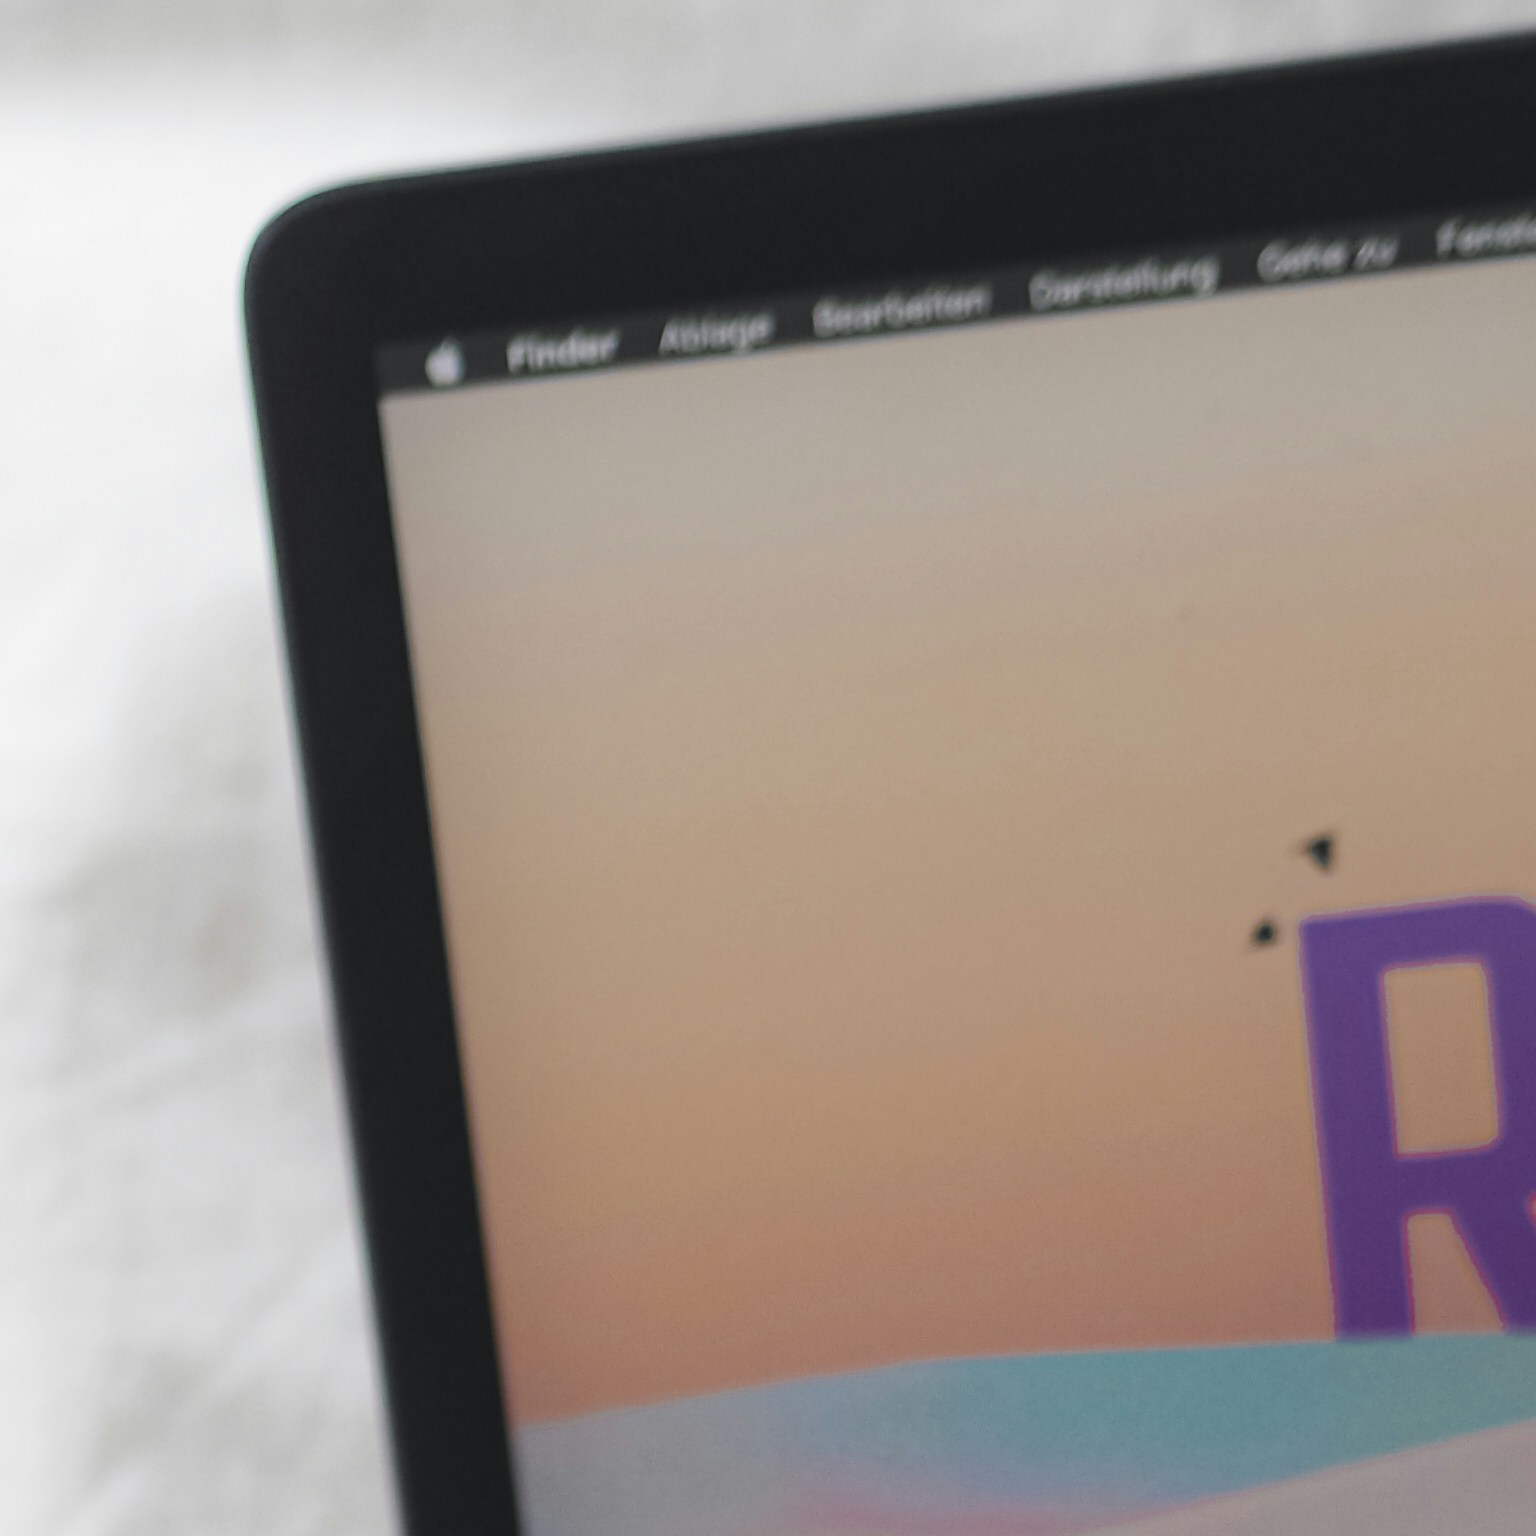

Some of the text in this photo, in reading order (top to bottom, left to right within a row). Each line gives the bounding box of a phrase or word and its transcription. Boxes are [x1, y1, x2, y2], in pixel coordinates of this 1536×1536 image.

[506, 329, 621, 375] Finder
[659, 311, 776, 357] Ablage
[812, 284, 993, 339] Bearbeiten
[1029, 255, 1221, 310] Darstellung
[1257, 235, 1349, 282] Gehe
[1354, 235, 1402, 271] zu
[1298, 893, 1536, 1342] R
